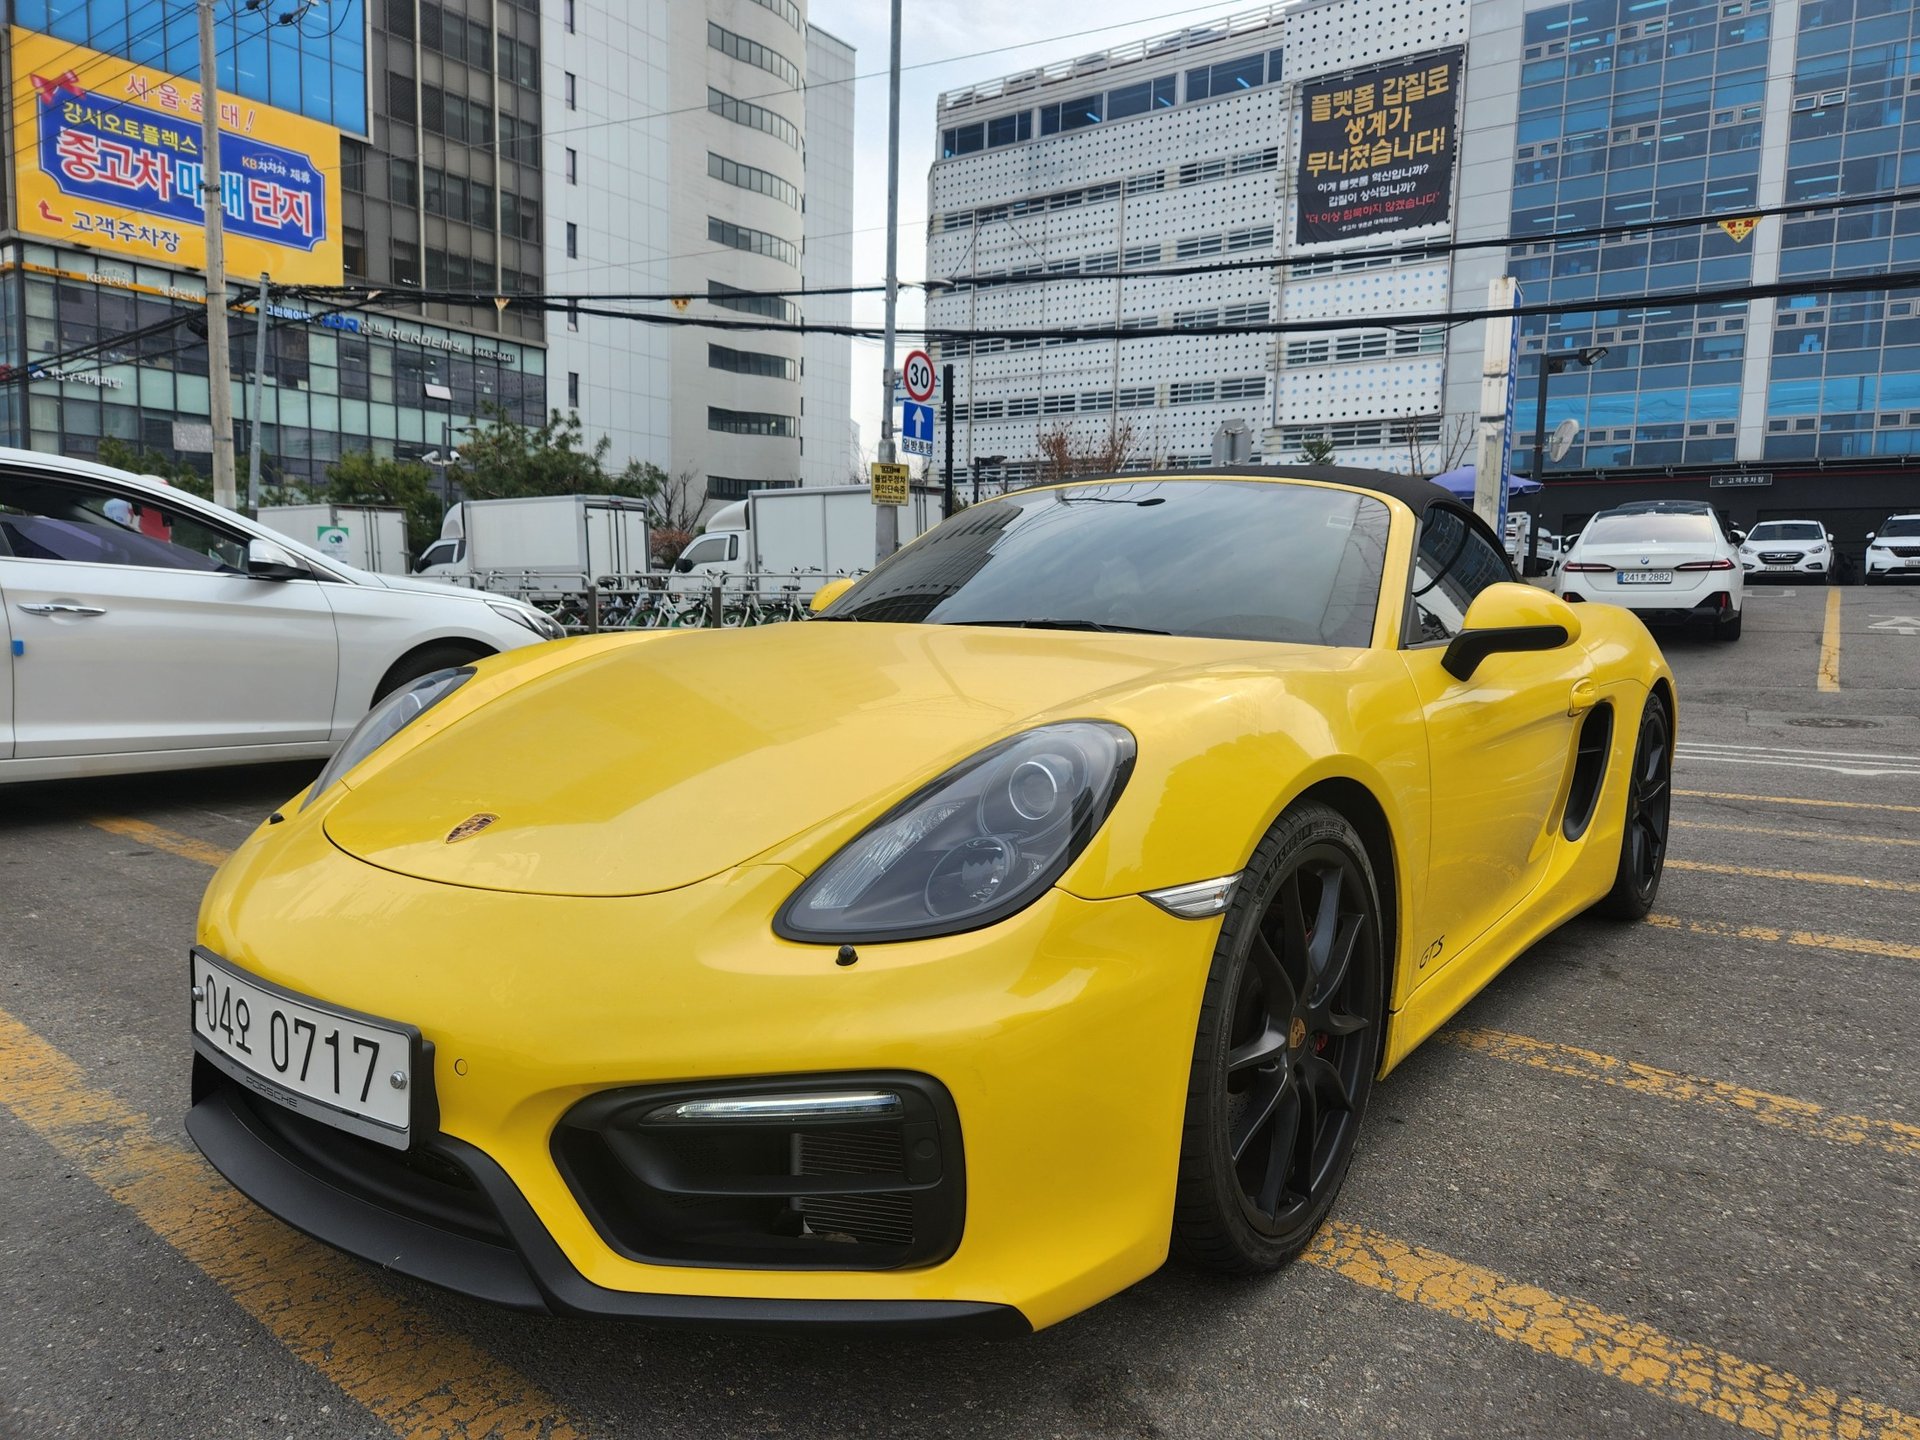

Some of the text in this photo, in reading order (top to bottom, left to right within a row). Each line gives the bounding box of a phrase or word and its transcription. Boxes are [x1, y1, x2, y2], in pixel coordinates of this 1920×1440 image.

[1311, 64, 1449, 122] 플랫폼 갑질로
[63, 101, 198, 154] 강서오토플렉스
[1344, 105, 1411, 145] 생계가
[1306, 126, 1446, 177] 무너졌습니다!
[1371, 164, 1429, 183] 혁신입니까?
[1328, 181, 1417, 207] 갑질이 상식입니까?
[72, 212, 180, 252] 고객주차장
[1321, 211, 1341, 223] 이상
[910, 363, 930, 389] 30
[903, 438, 933, 455] 일방통행
[1648, 573, 1670, 582] 2882
[1419, 934, 1445, 970] GTS
[206, 974, 380, 1103] 04오 0717
[246, 1075, 298, 1108] PORSCHE
